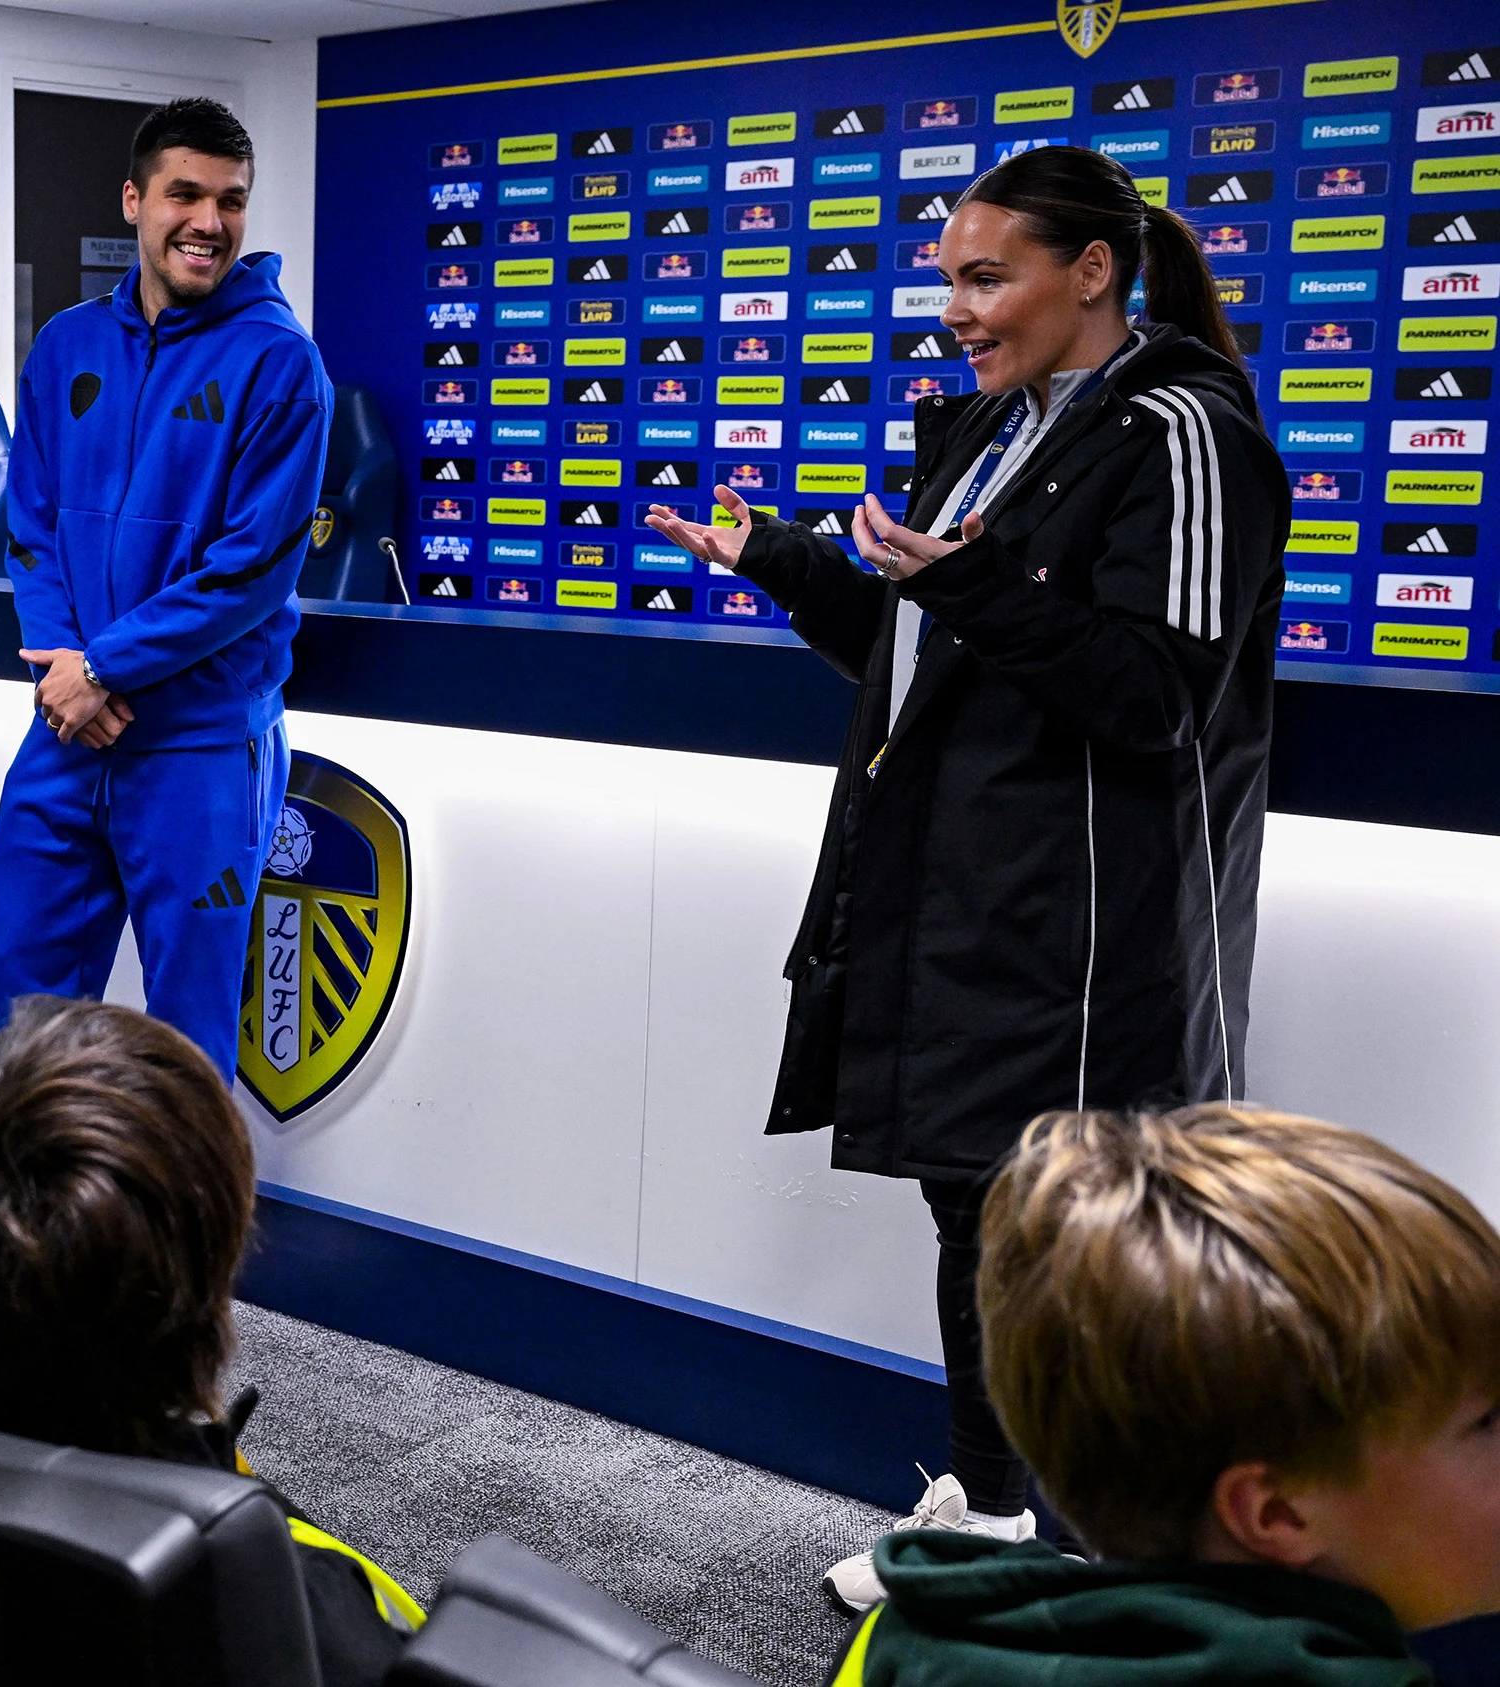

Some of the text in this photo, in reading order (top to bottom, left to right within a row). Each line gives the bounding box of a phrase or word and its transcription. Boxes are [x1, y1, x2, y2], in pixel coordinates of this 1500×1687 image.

[1311, 70, 1391, 83] PARIMATCH
[1000, 100, 1067, 111] PARIMATCH
[733, 124, 791, 134] PARIMATCH
[1437, 113, 1494, 134] amt
[1313, 125, 1380, 138] Hisense
[502, 145, 552, 153] PARIMATCH
[1099, 141, 1160, 154] Hisense
[1211, 138, 1255, 153] LAND
[821, 164, 872, 174] Hisense
[655, 176, 702, 186] Hisense
[740, 168, 779, 184] amt
[505, 187, 548, 196] Hisense
[584, 186, 616, 198] LAND
[814, 209, 875, 217] PARIMATCH
[1298, 229, 1377, 238] PARIMATCH
[727, 258, 784, 266] PARIMATCH
[1300, 281, 1366, 293] Hisense
[1423, 275, 1479, 294] amt
[814, 300, 865, 310] Hisense
[906, 297, 950, 306] BURFLE
[501, 310, 544, 318] Hisense
[650, 305, 696, 314] Hisense
[734, 302, 773, 316] amt
[580, 312, 612, 323] LAND
[1406, 330, 1489, 338] PARIMATCH
[1004, 404, 1025, 434] STAFF
[498, 428, 540, 437] Hisense
[645, 428, 691, 438] Hisense
[729, 429, 767, 442] amt
[808, 430, 858, 440] Hisense
[1288, 431, 1354, 442] Hisense
[576, 433, 608, 444] LAND
[1410, 431, 1465, 447] amt
[961, 482, 981, 510] STAFF
[494, 547, 536, 556] Hisense
[572, 555, 604, 566] LAND
[641, 553, 686, 564] Hisense
[561, 590, 612, 598] PARIMATCH
[1396, 587, 1451, 602] amt
[1380, 636, 1461, 646] PARIMATCH
[266, 902, 298, 1061] LUFC
